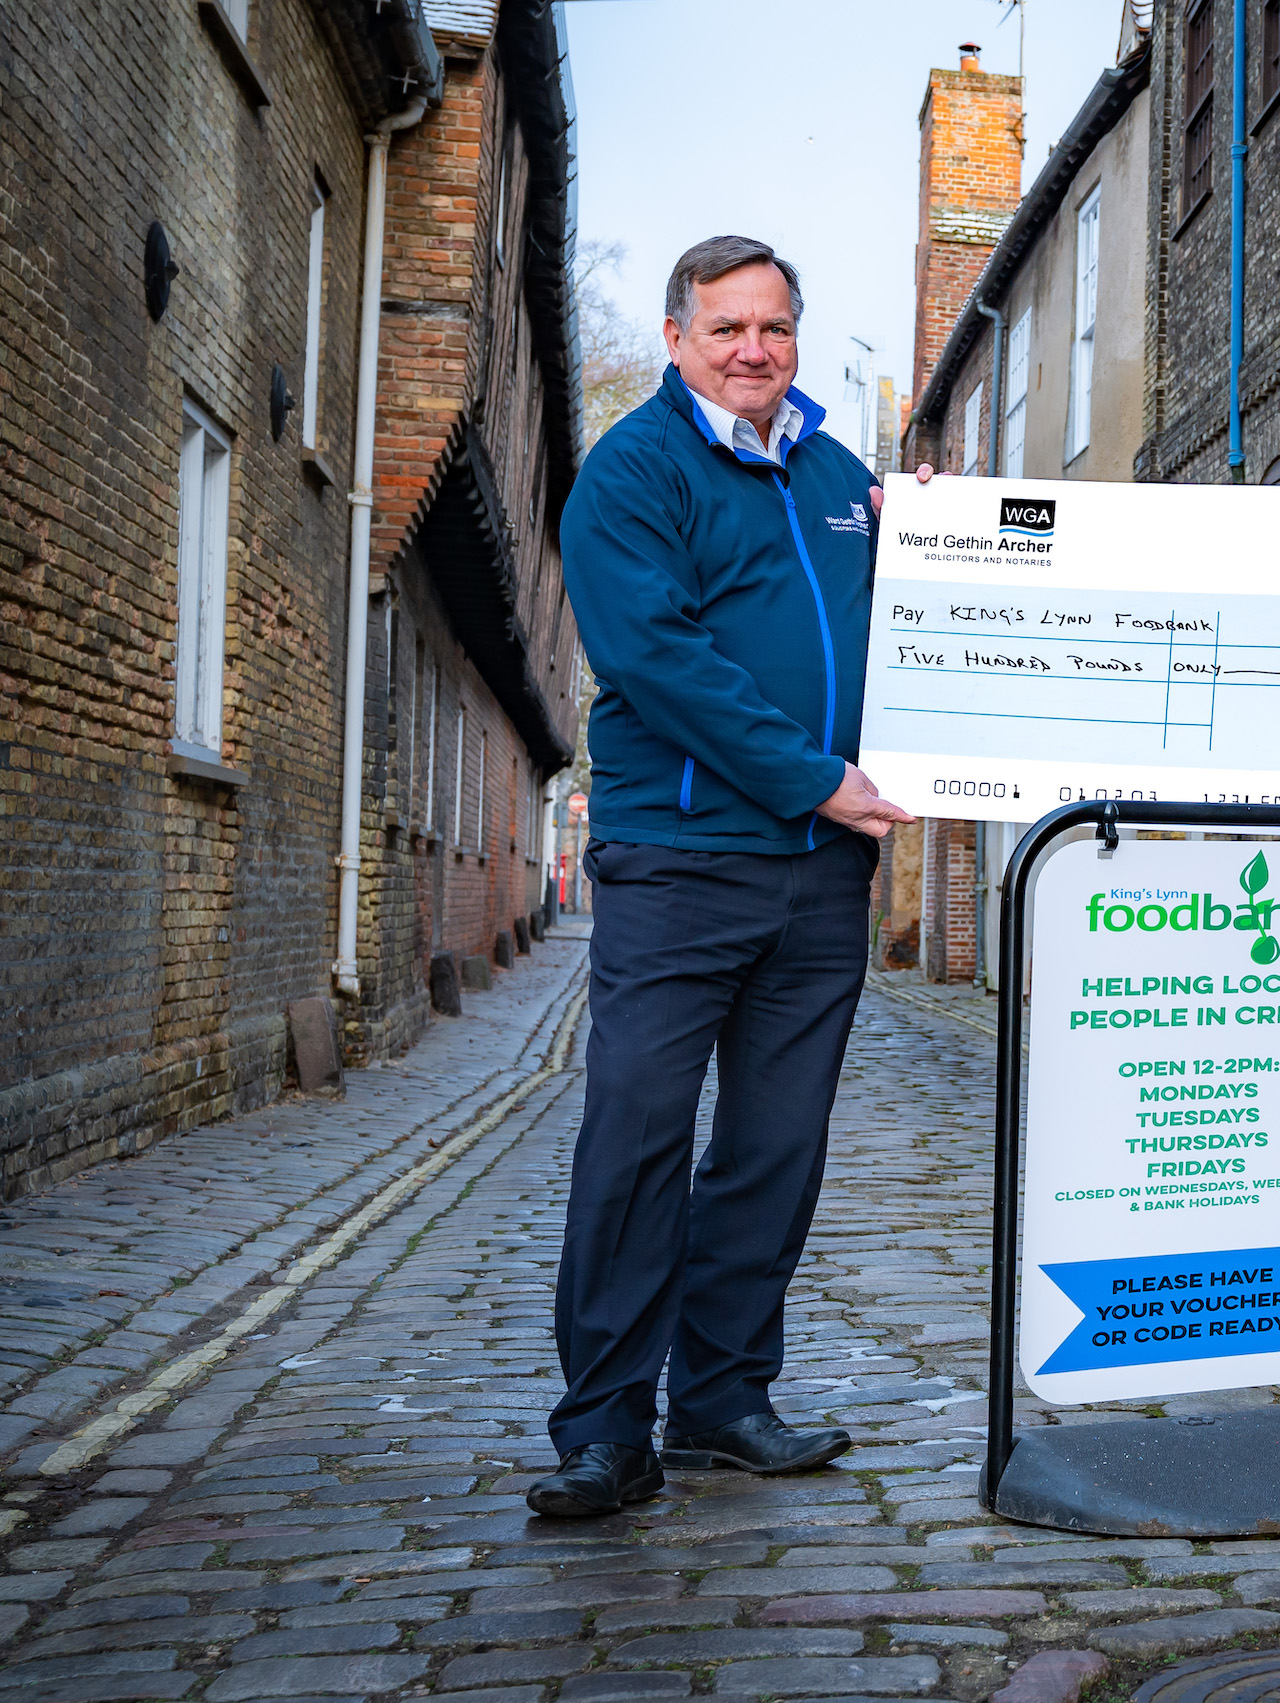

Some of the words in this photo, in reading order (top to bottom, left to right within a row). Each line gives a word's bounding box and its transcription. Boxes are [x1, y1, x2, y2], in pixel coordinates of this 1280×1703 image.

[1005, 507, 1051, 524] WGA
[898, 532, 938, 549] Ward
[943, 535, 993, 551] Gethin
[998, 537, 1053, 554] Archer
[924, 553, 980, 563] SOLICITORS
[983, 556, 1003, 565] AND
[1005, 557, 1052, 567] NOTARIES
[893, 606, 925, 624] Pay
[950, 605, 1026, 627] KING'S
[1040, 610, 1092, 627] LYNN
[1110, 889, 1153, 902] King's
[1156, 889, 1188, 900] Lynn
[1082, 975, 1214, 997] HELPING
[1070, 1008, 1188, 1030] PEOPLE
[1197, 1007, 1226, 1026] IN
[1118, 1060, 1186, 1078] OPEN
[1193, 1057, 1280, 1074] 12-2PM:
[1140, 1082, 1258, 1103] MONDAYS
[1136, 1107, 1260, 1128] TUESDAYS
[1125, 1132, 1269, 1154] THURSDAYS
[1147, 1158, 1246, 1178] FRIDAYS
[1054, 1188, 1115, 1202] CLOSED
[1119, 1187, 1141, 1198] ON
[1145, 1181, 1249, 1196] WEDNESDAYS,
[1129, 1201, 1140, 1212] &
[1144, 1199, 1185, 1211] BANK
[1189, 1194, 1260, 1208] HOLIDAYS
[1112, 1273, 1203, 1295] PLEASE
[1210, 1268, 1274, 1287] HAVE
[1096, 1302, 1164, 1322] YOUR
[1092, 1330, 1127, 1347] OR
[1134, 1323, 1202, 1344] CODE
